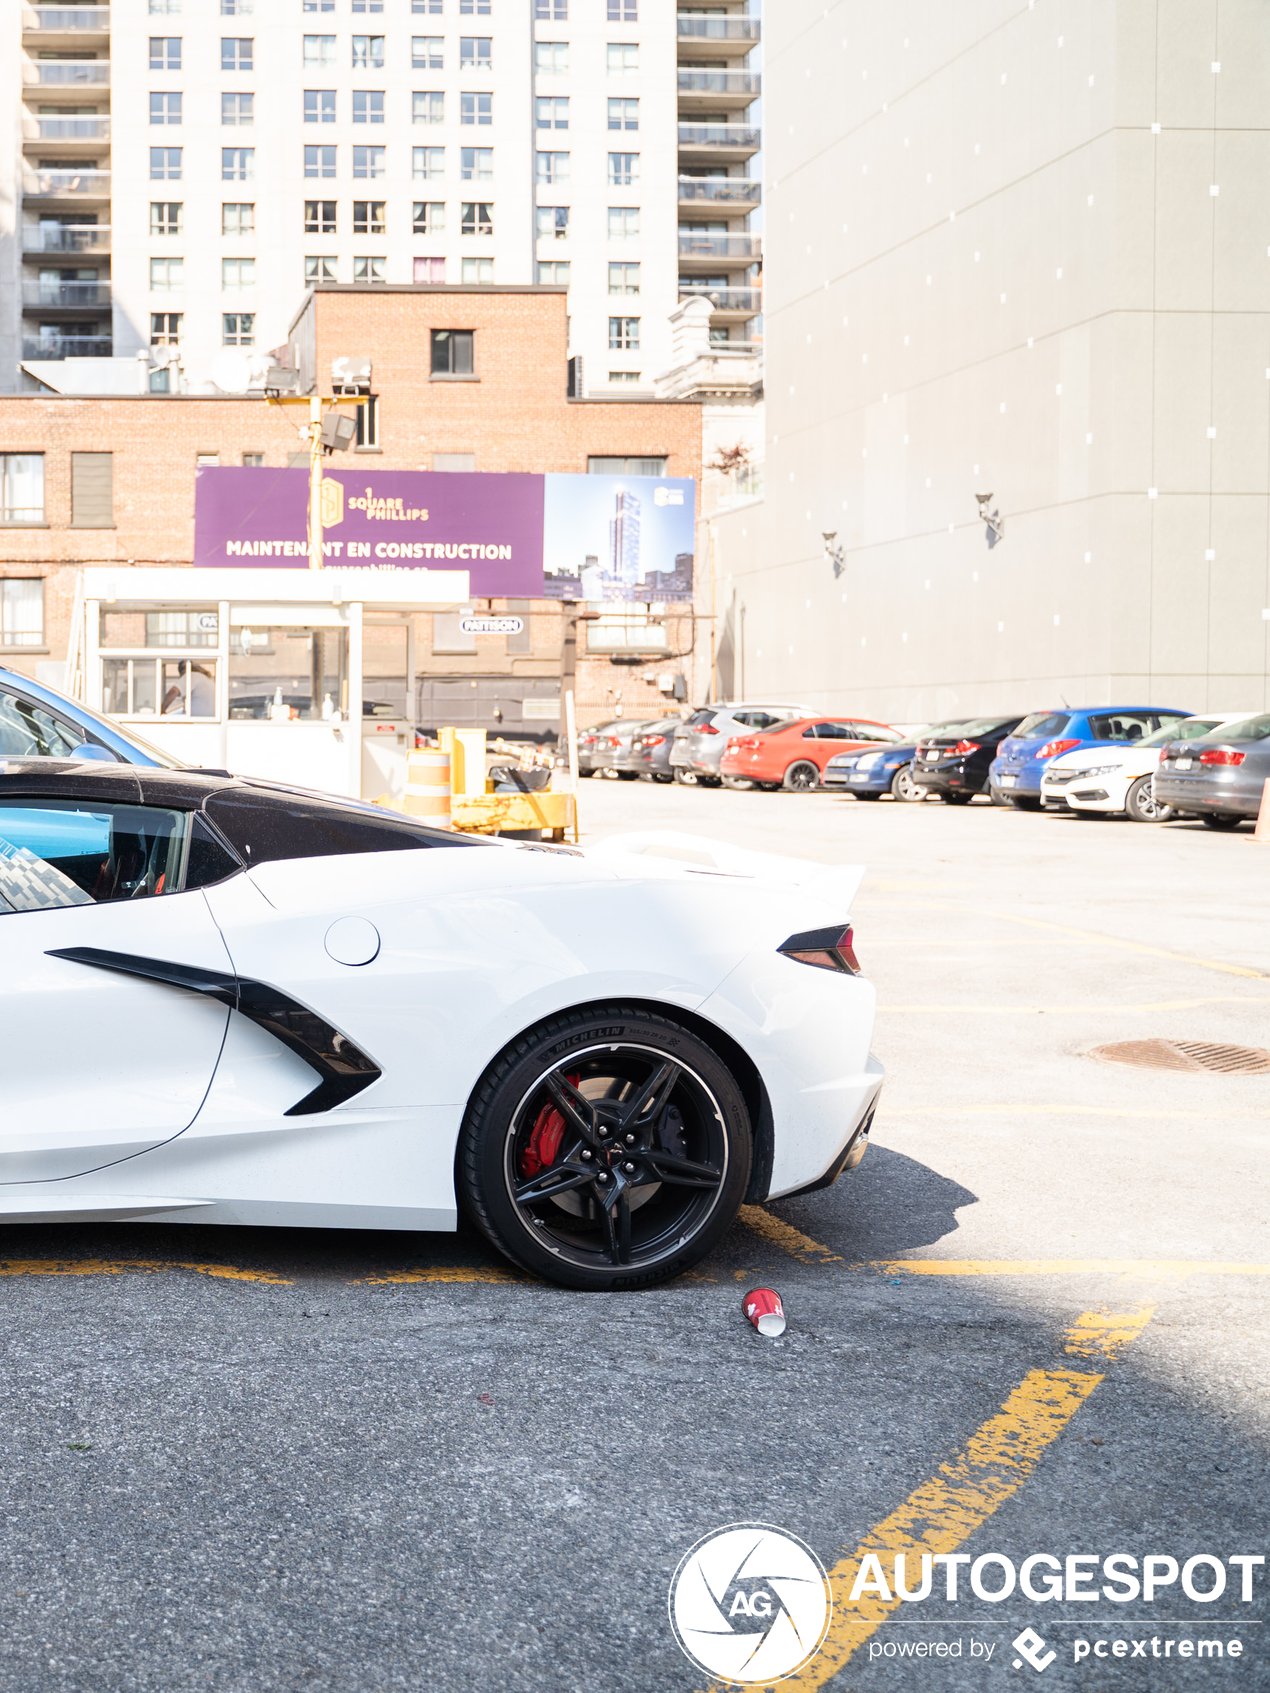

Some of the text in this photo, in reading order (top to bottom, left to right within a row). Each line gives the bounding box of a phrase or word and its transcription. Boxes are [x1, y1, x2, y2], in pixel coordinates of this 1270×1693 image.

[348, 497, 403, 511] SQUARE
[366, 508, 429, 521] PHILLIPS
[346, 542, 373, 558] EN
[375, 542, 512, 560] CONSTRUCTION
[464, 620, 518, 632] PATTISON
[555, 1027, 621, 1053] MICHELIN
